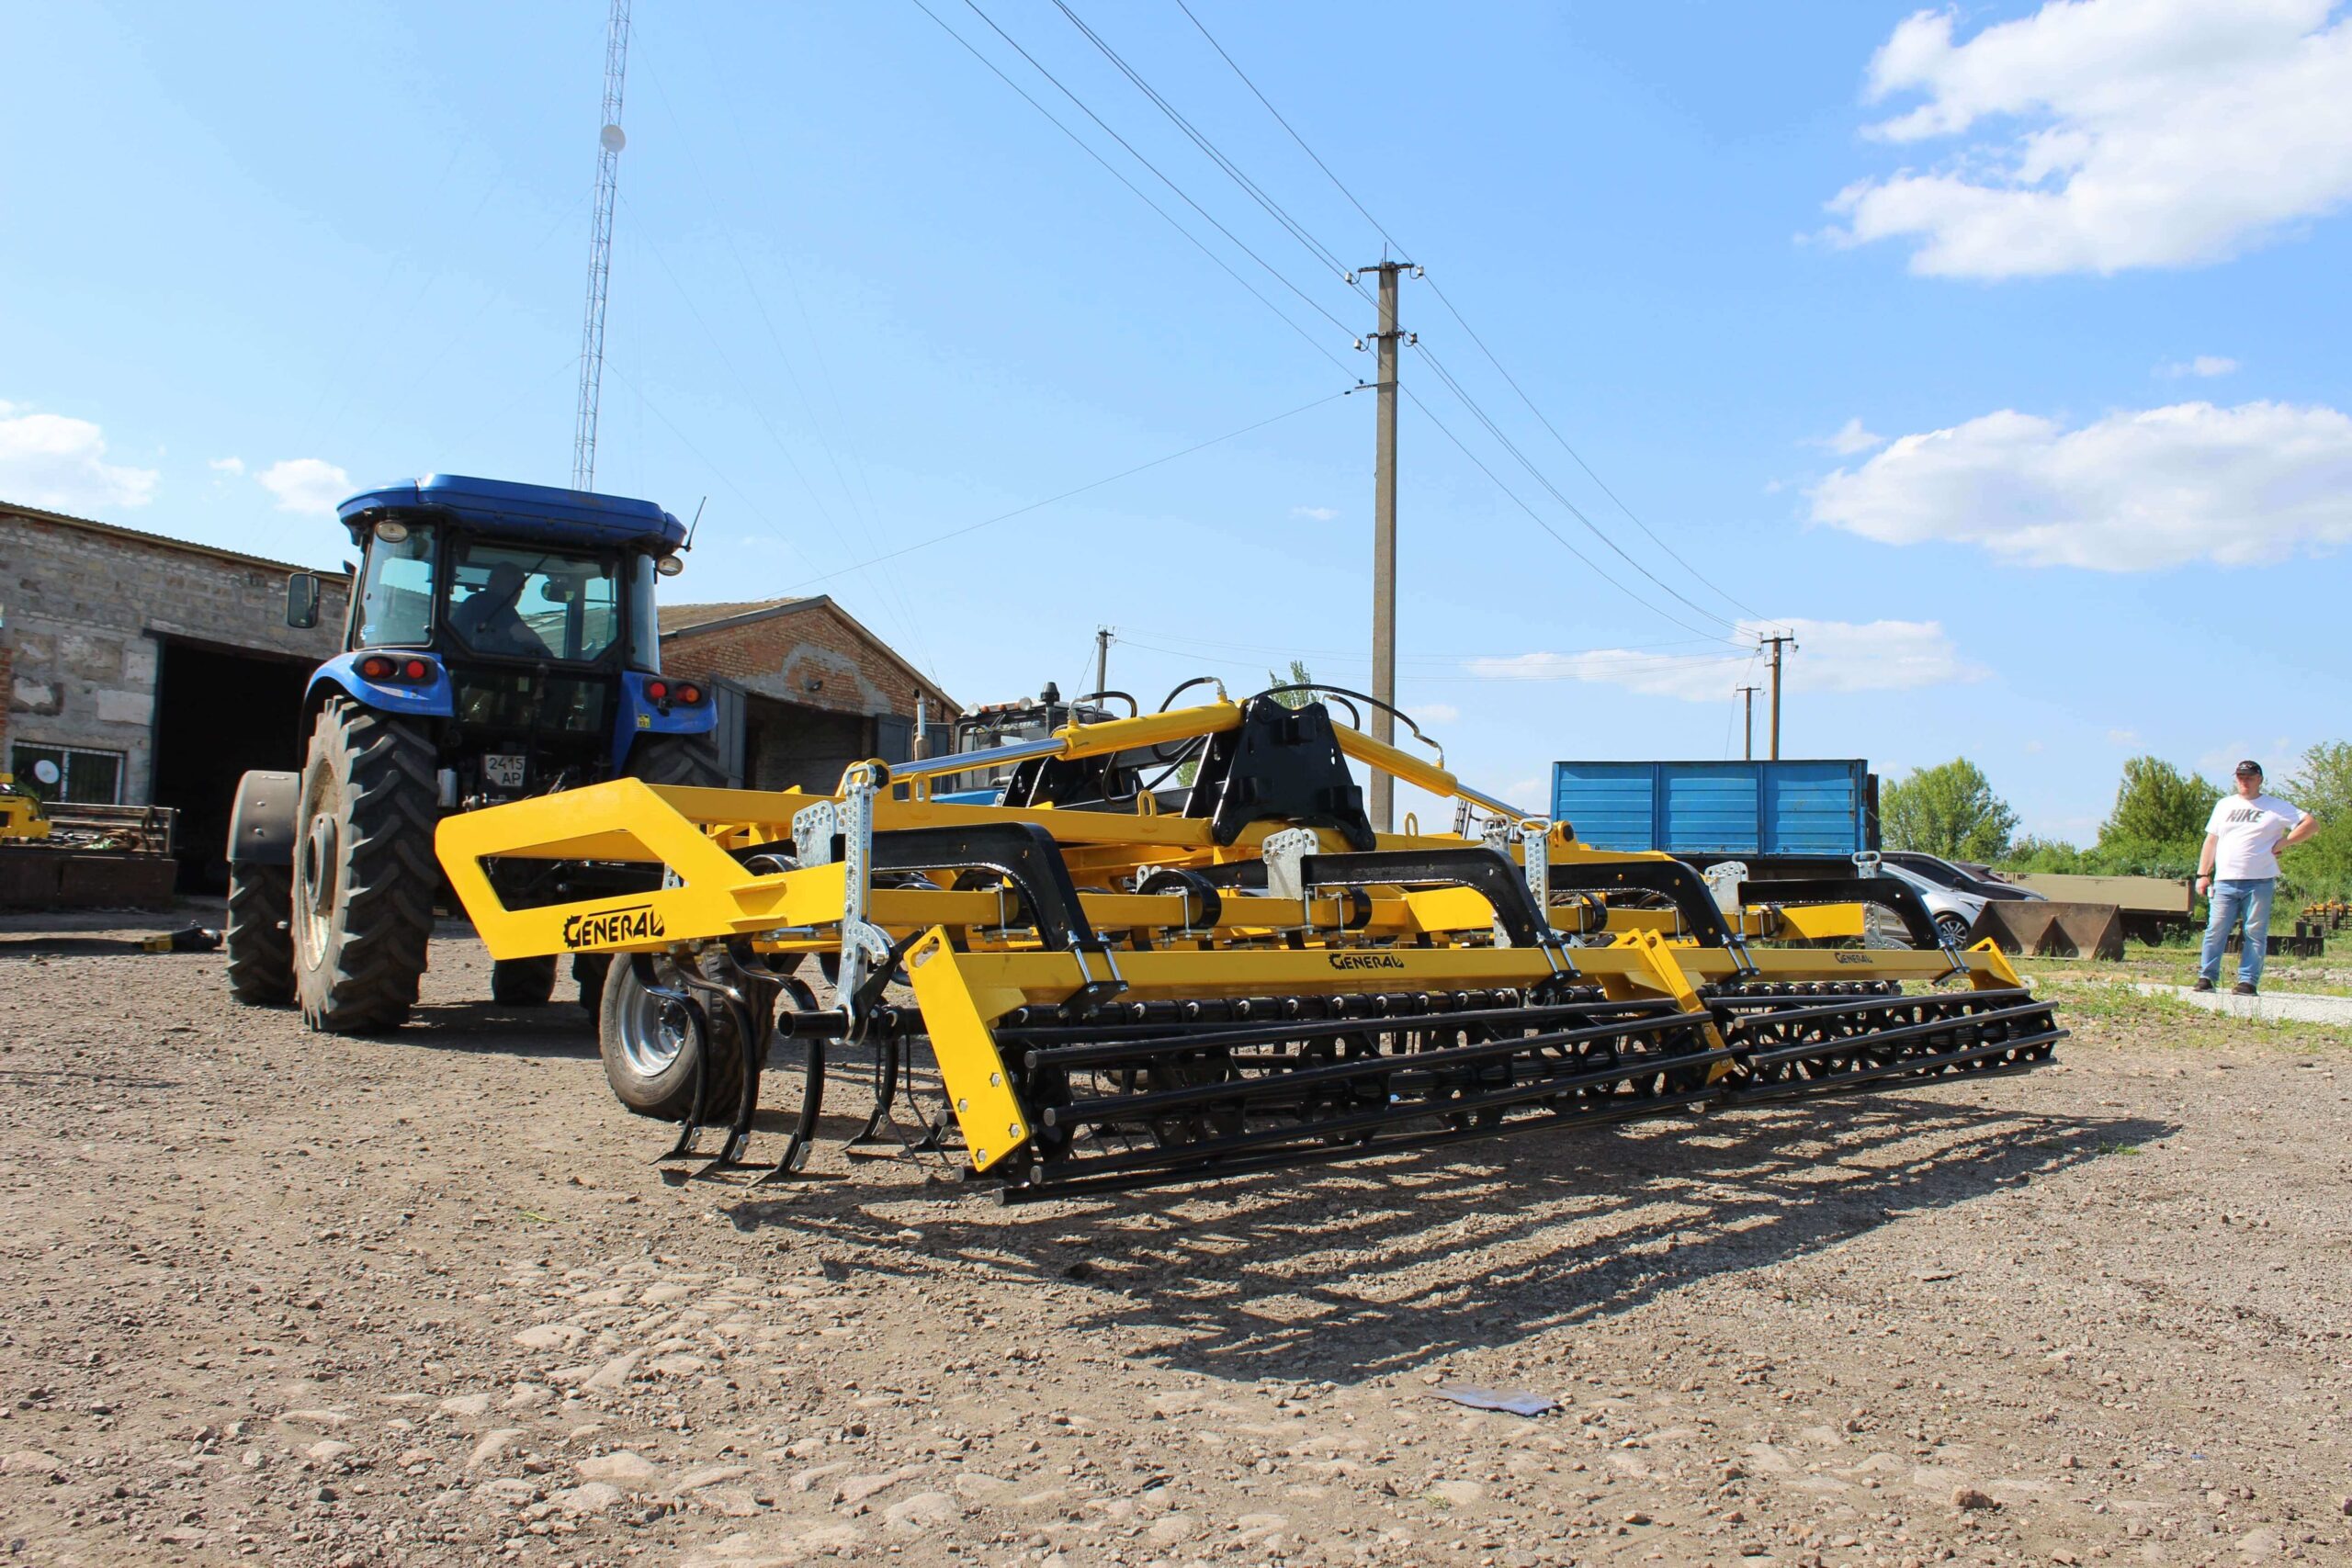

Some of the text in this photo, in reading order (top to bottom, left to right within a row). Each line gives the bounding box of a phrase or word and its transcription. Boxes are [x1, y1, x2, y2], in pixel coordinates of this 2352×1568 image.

[489, 757, 524, 771] 2415
[2226, 809, 2265, 823] NIKE
[562, 908, 665, 950] GENERAL
[1328, 953, 1405, 970] GENERAL
